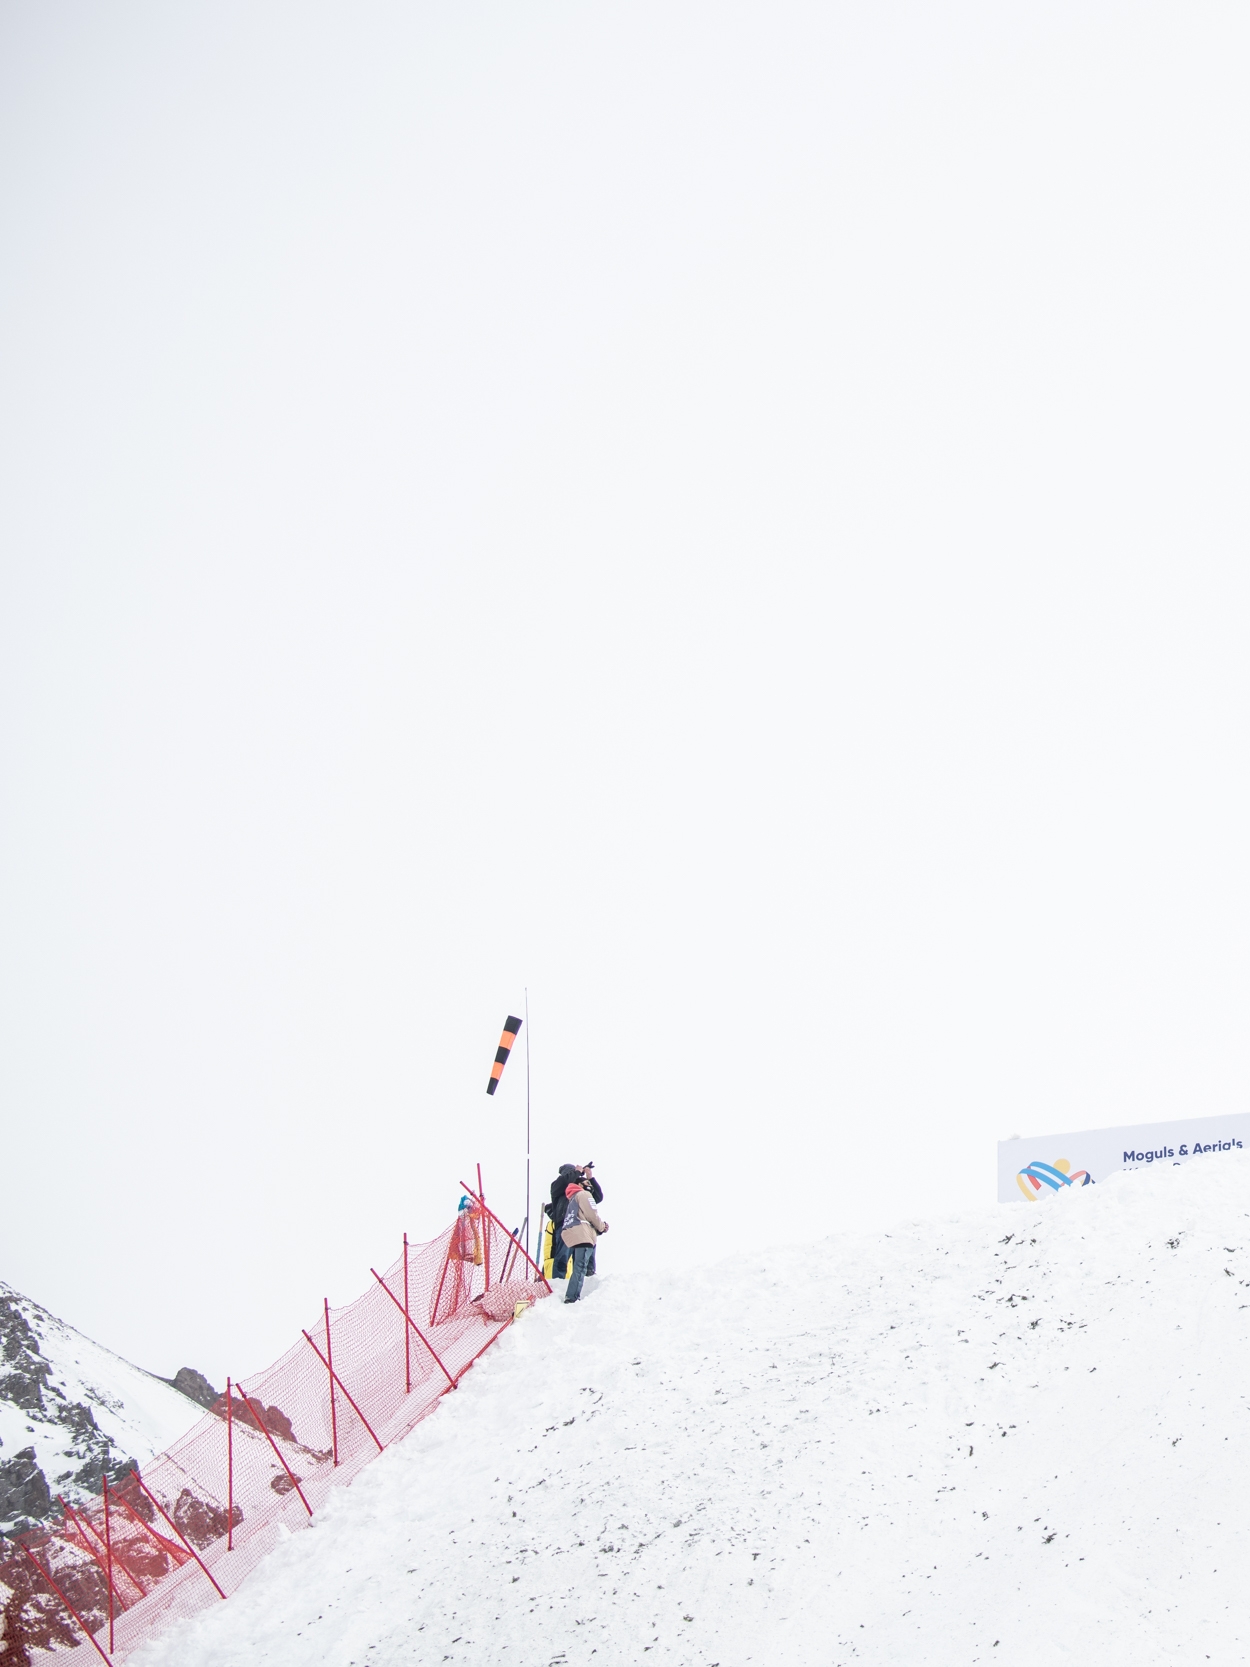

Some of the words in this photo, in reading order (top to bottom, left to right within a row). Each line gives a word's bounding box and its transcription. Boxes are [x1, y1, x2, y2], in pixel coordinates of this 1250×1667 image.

[1123, 1146, 1175, 1163] Moguls
[1178, 1144, 1189, 1156] &
[1192, 1138, 1244, 1154] Aerials
